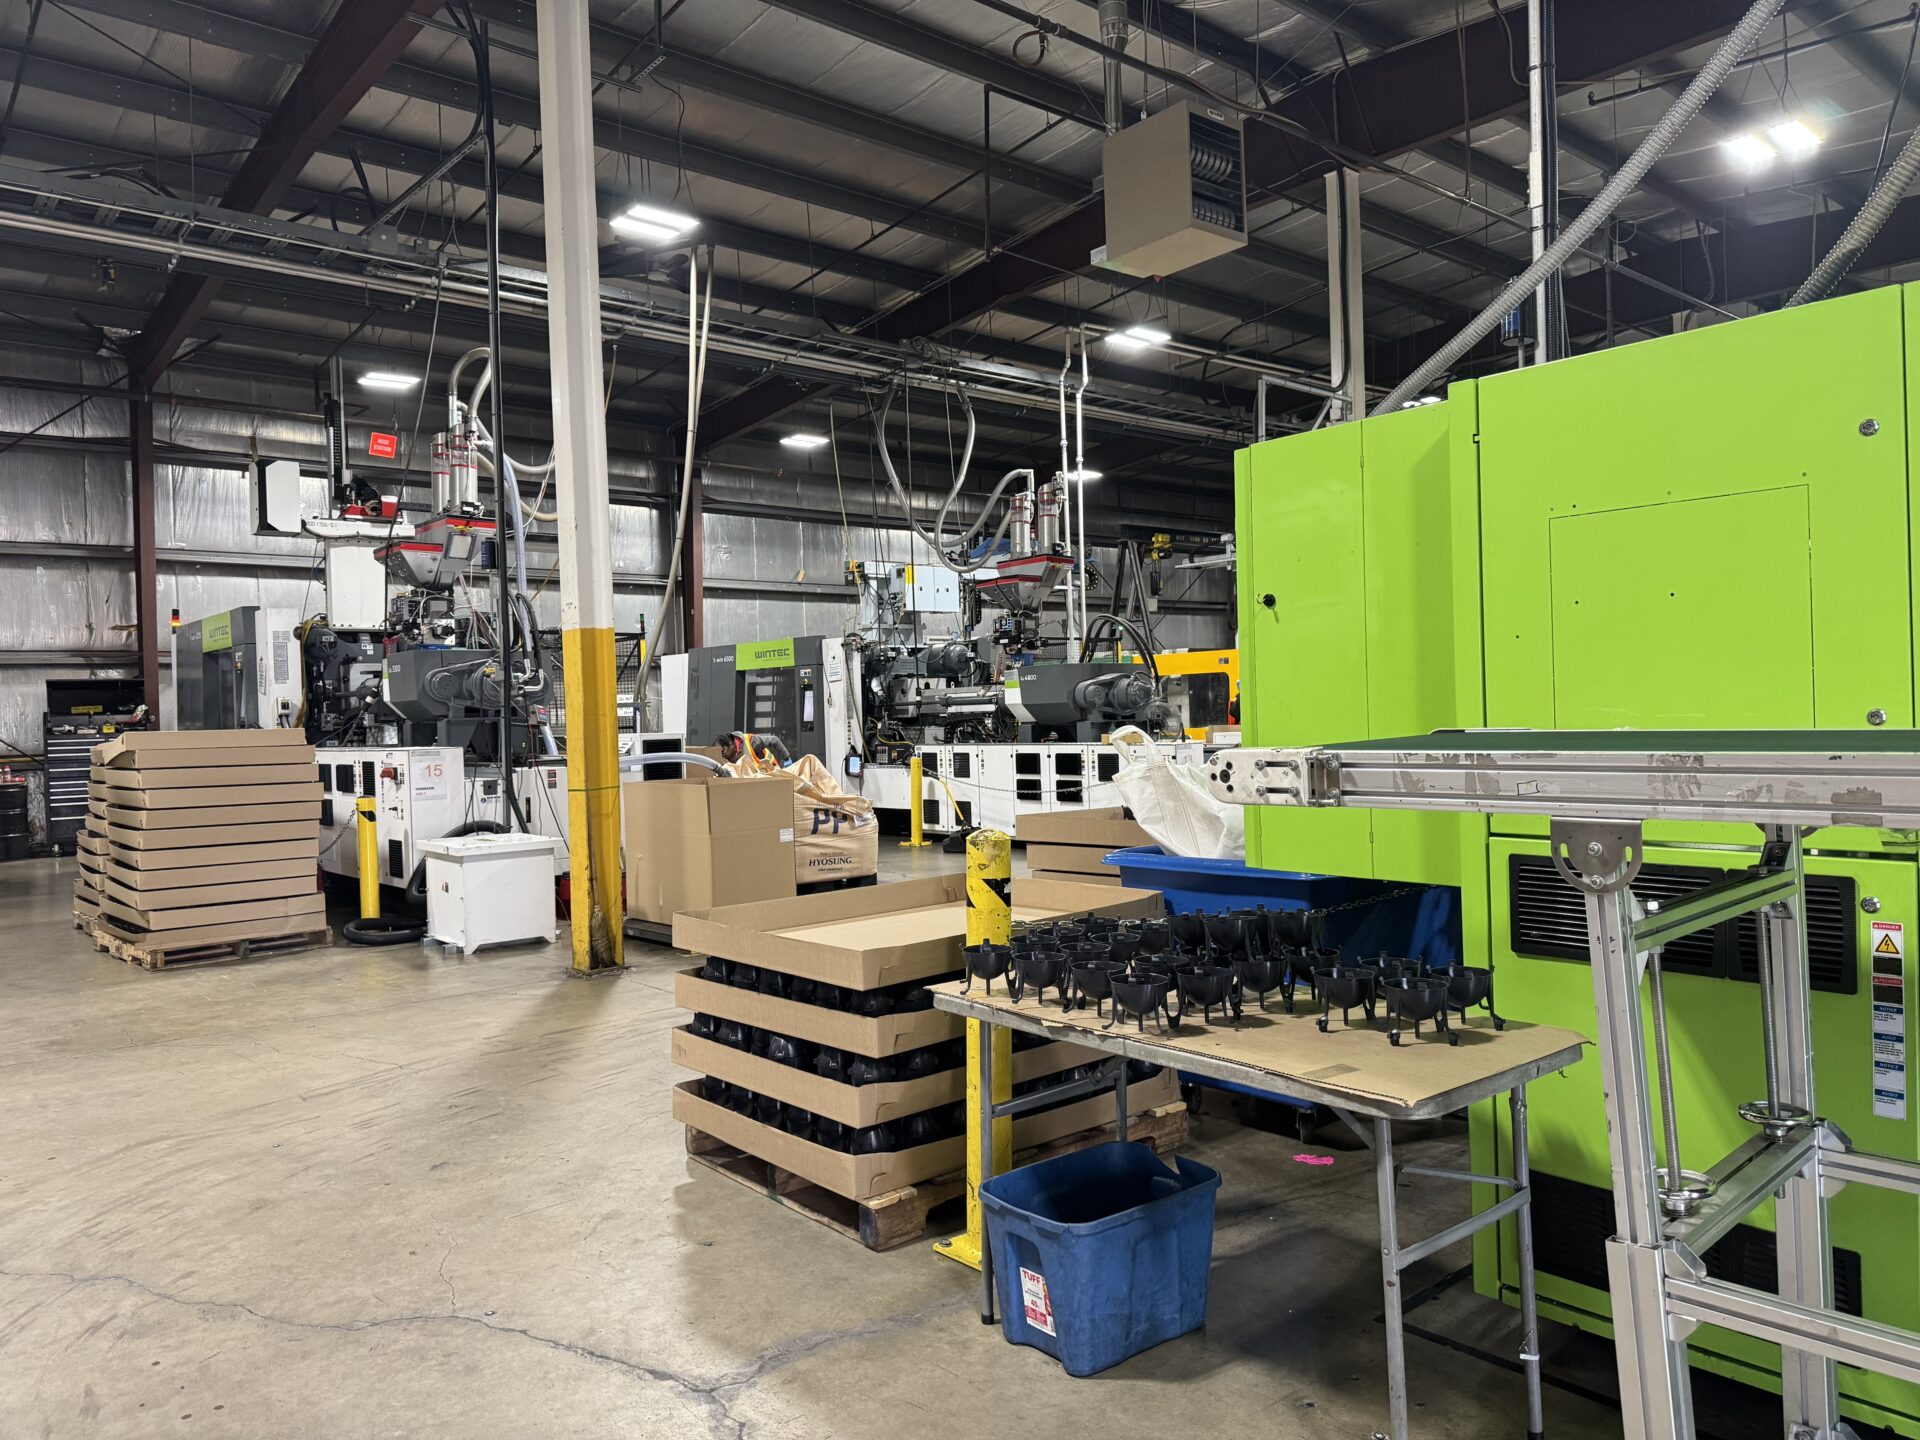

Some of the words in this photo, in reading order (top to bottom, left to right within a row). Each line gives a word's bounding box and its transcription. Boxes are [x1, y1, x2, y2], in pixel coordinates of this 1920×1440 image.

[754, 648, 791, 659] WINTEC
[425, 764, 443, 777] 15
[811, 808, 849, 835] PP
[808, 857, 852, 866] HYOSUNG
[1879, 1062, 1899, 1070] NOTICE
[1022, 1269, 1041, 1284] TUFF
